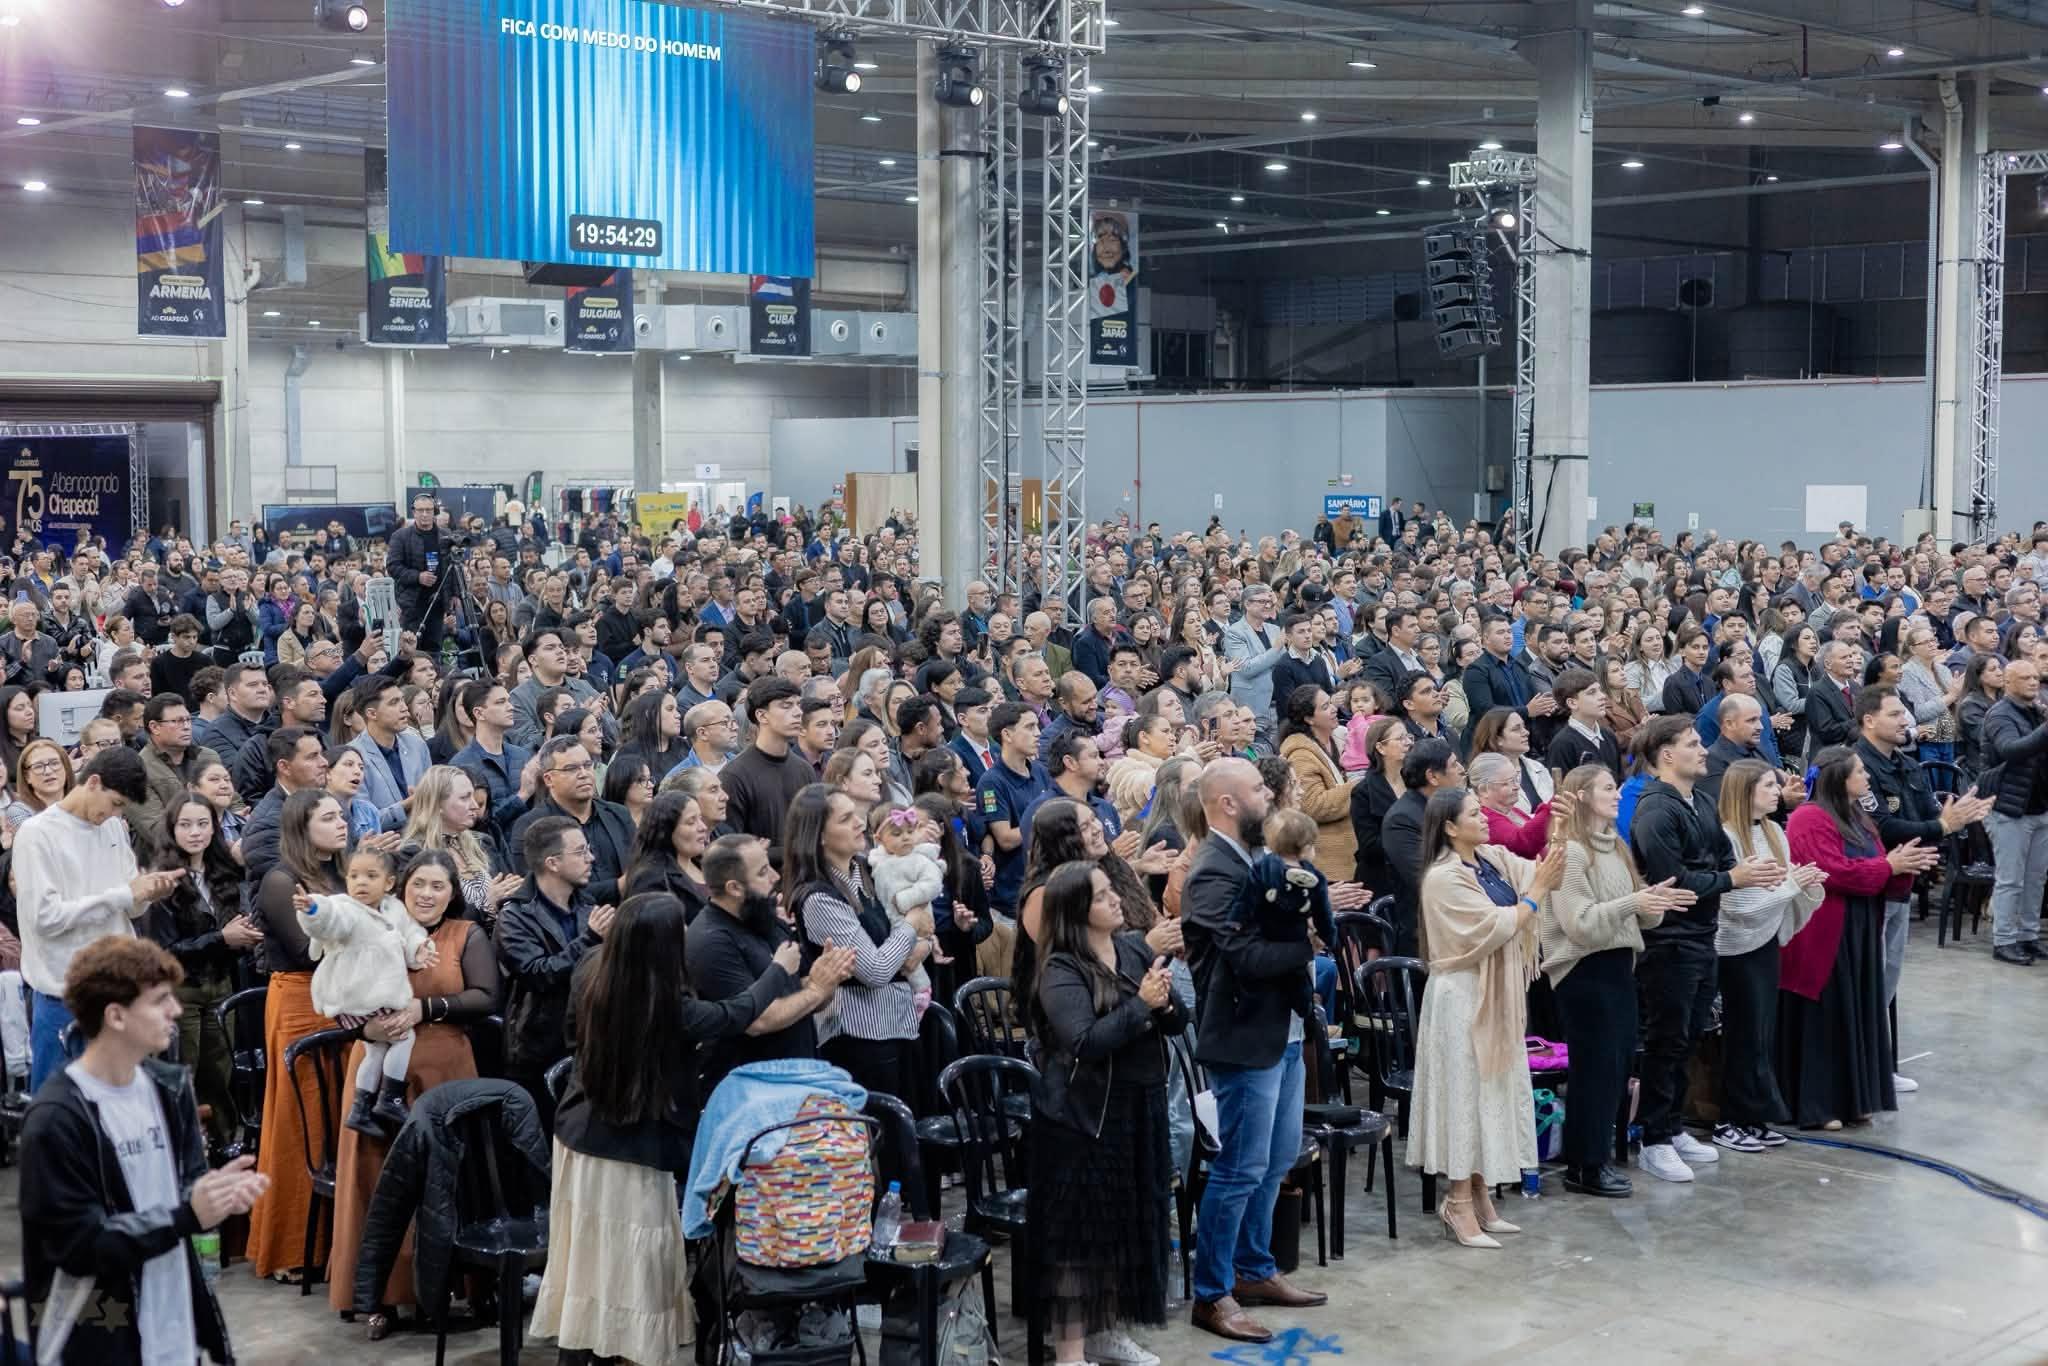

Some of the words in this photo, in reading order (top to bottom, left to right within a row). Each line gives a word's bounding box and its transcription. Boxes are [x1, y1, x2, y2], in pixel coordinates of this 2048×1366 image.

[501, 17, 537, 37] FICA
[540, 23, 579, 42] COM
[583, 29, 631, 49] MEDO
[634, 36, 658, 52] DO
[661, 40, 721, 61] HOMEM
[576, 222, 657, 248] 19:54:29
[149, 284, 212, 300] ARMENIA
[389, 297, 432, 309] SENEGAL
[579, 307, 622, 319] BULGÁRIA
[768, 313, 795, 325] CUBA
[1101, 327, 1127, 338] JAPÃO
[49, 472, 120, 496] Abençoando
[8, 470, 45, 532] 75
[48, 492, 99, 519] Chapecó!
[1328, 498, 1367, 509] SANITÁRIO
